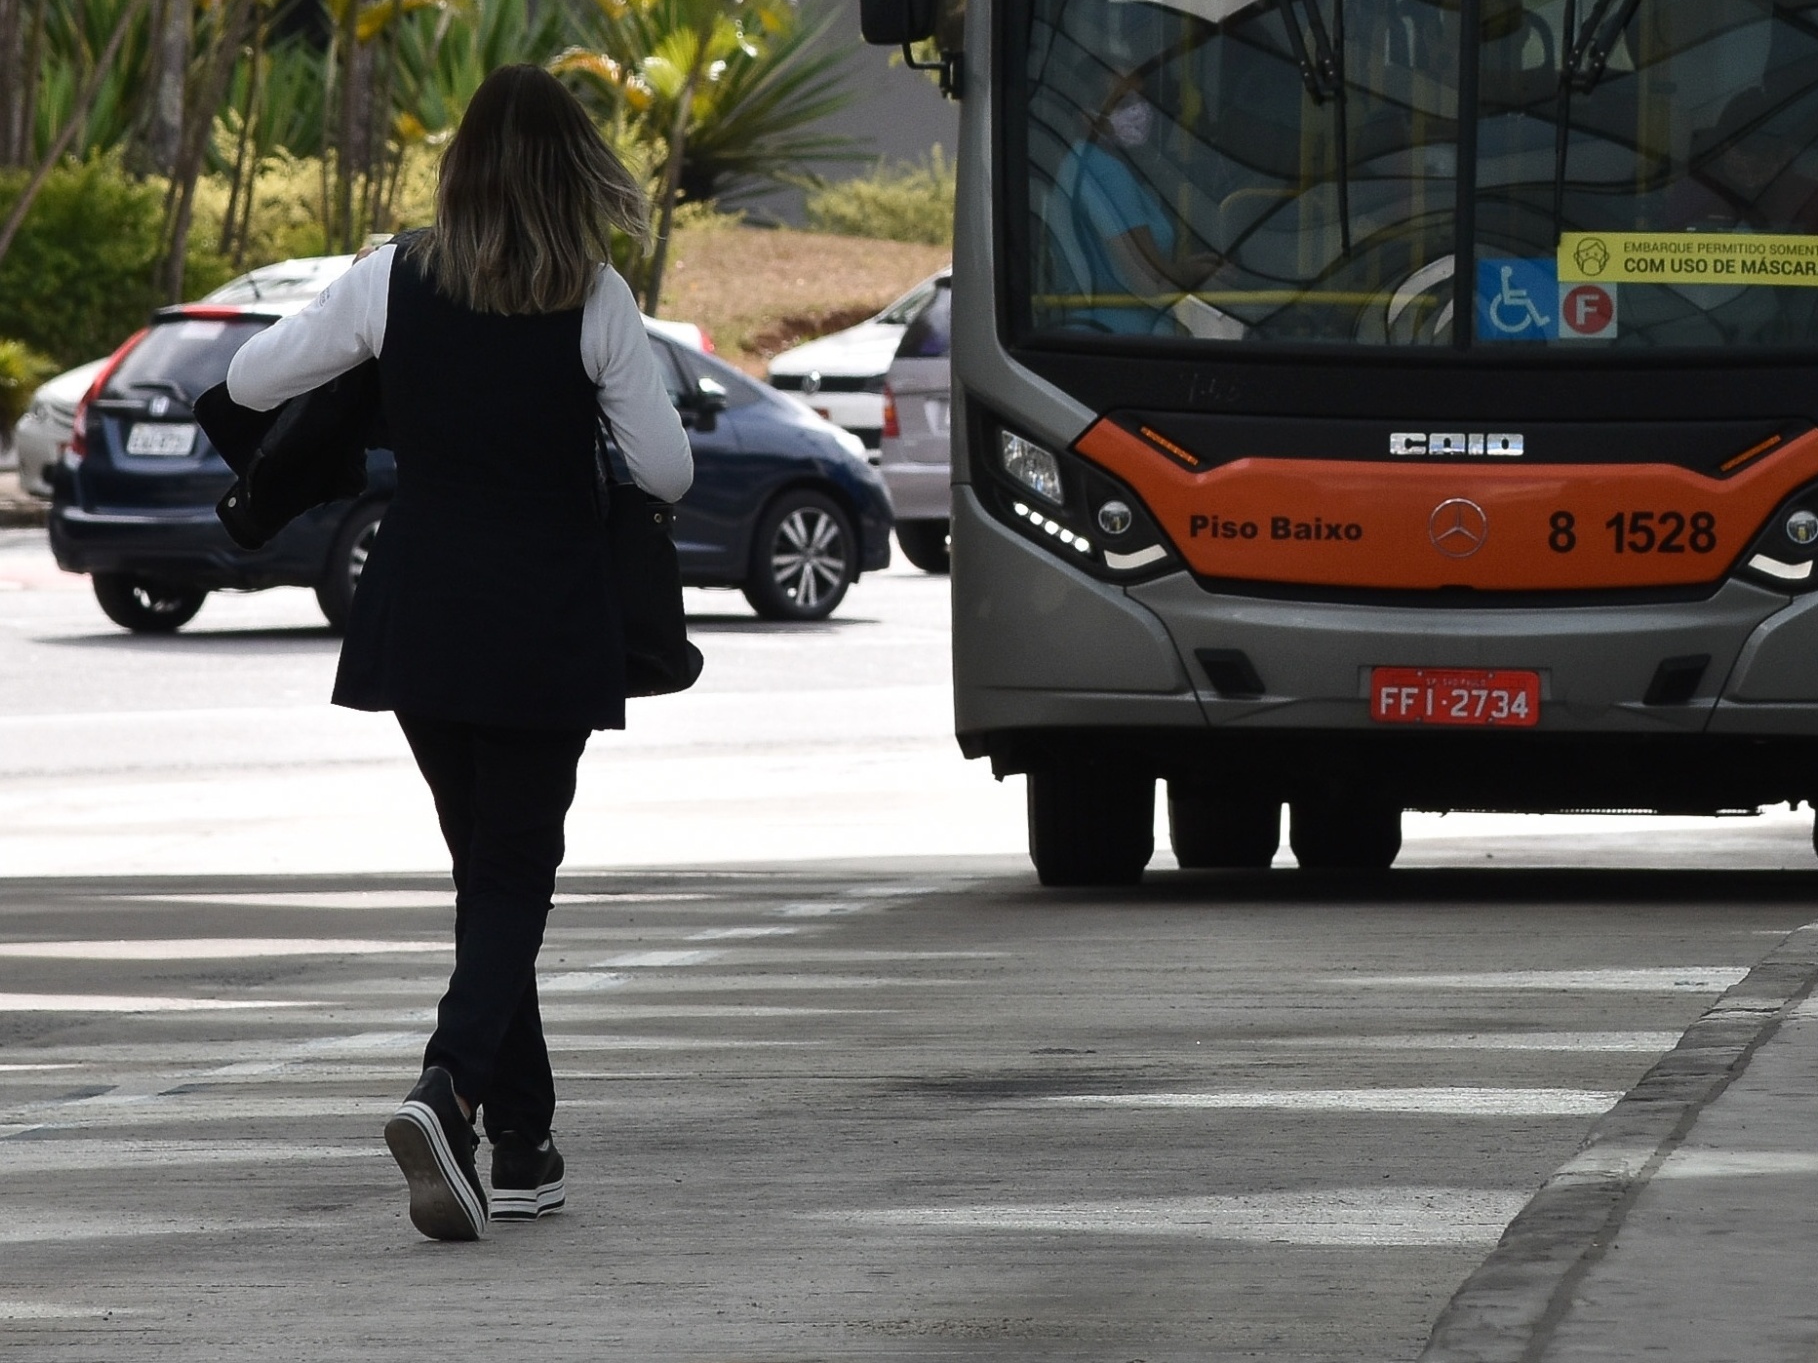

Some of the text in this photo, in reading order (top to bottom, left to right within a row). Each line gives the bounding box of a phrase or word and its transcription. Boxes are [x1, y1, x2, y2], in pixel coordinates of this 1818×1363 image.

[1624, 241, 1694, 254] EMBARQUE
[1697, 242, 1766, 255] PERMITIDO
[1624, 258, 1667, 273] COM
[1670, 258, 1709, 274] USO
[1713, 259, 1736, 274] DE
[1576, 294, 1599, 326] F
[1390, 432, 1524, 456] CAIO
[1189, 514, 1363, 542] Piso Baixo
[1548, 511, 1717, 554] 8 1528
